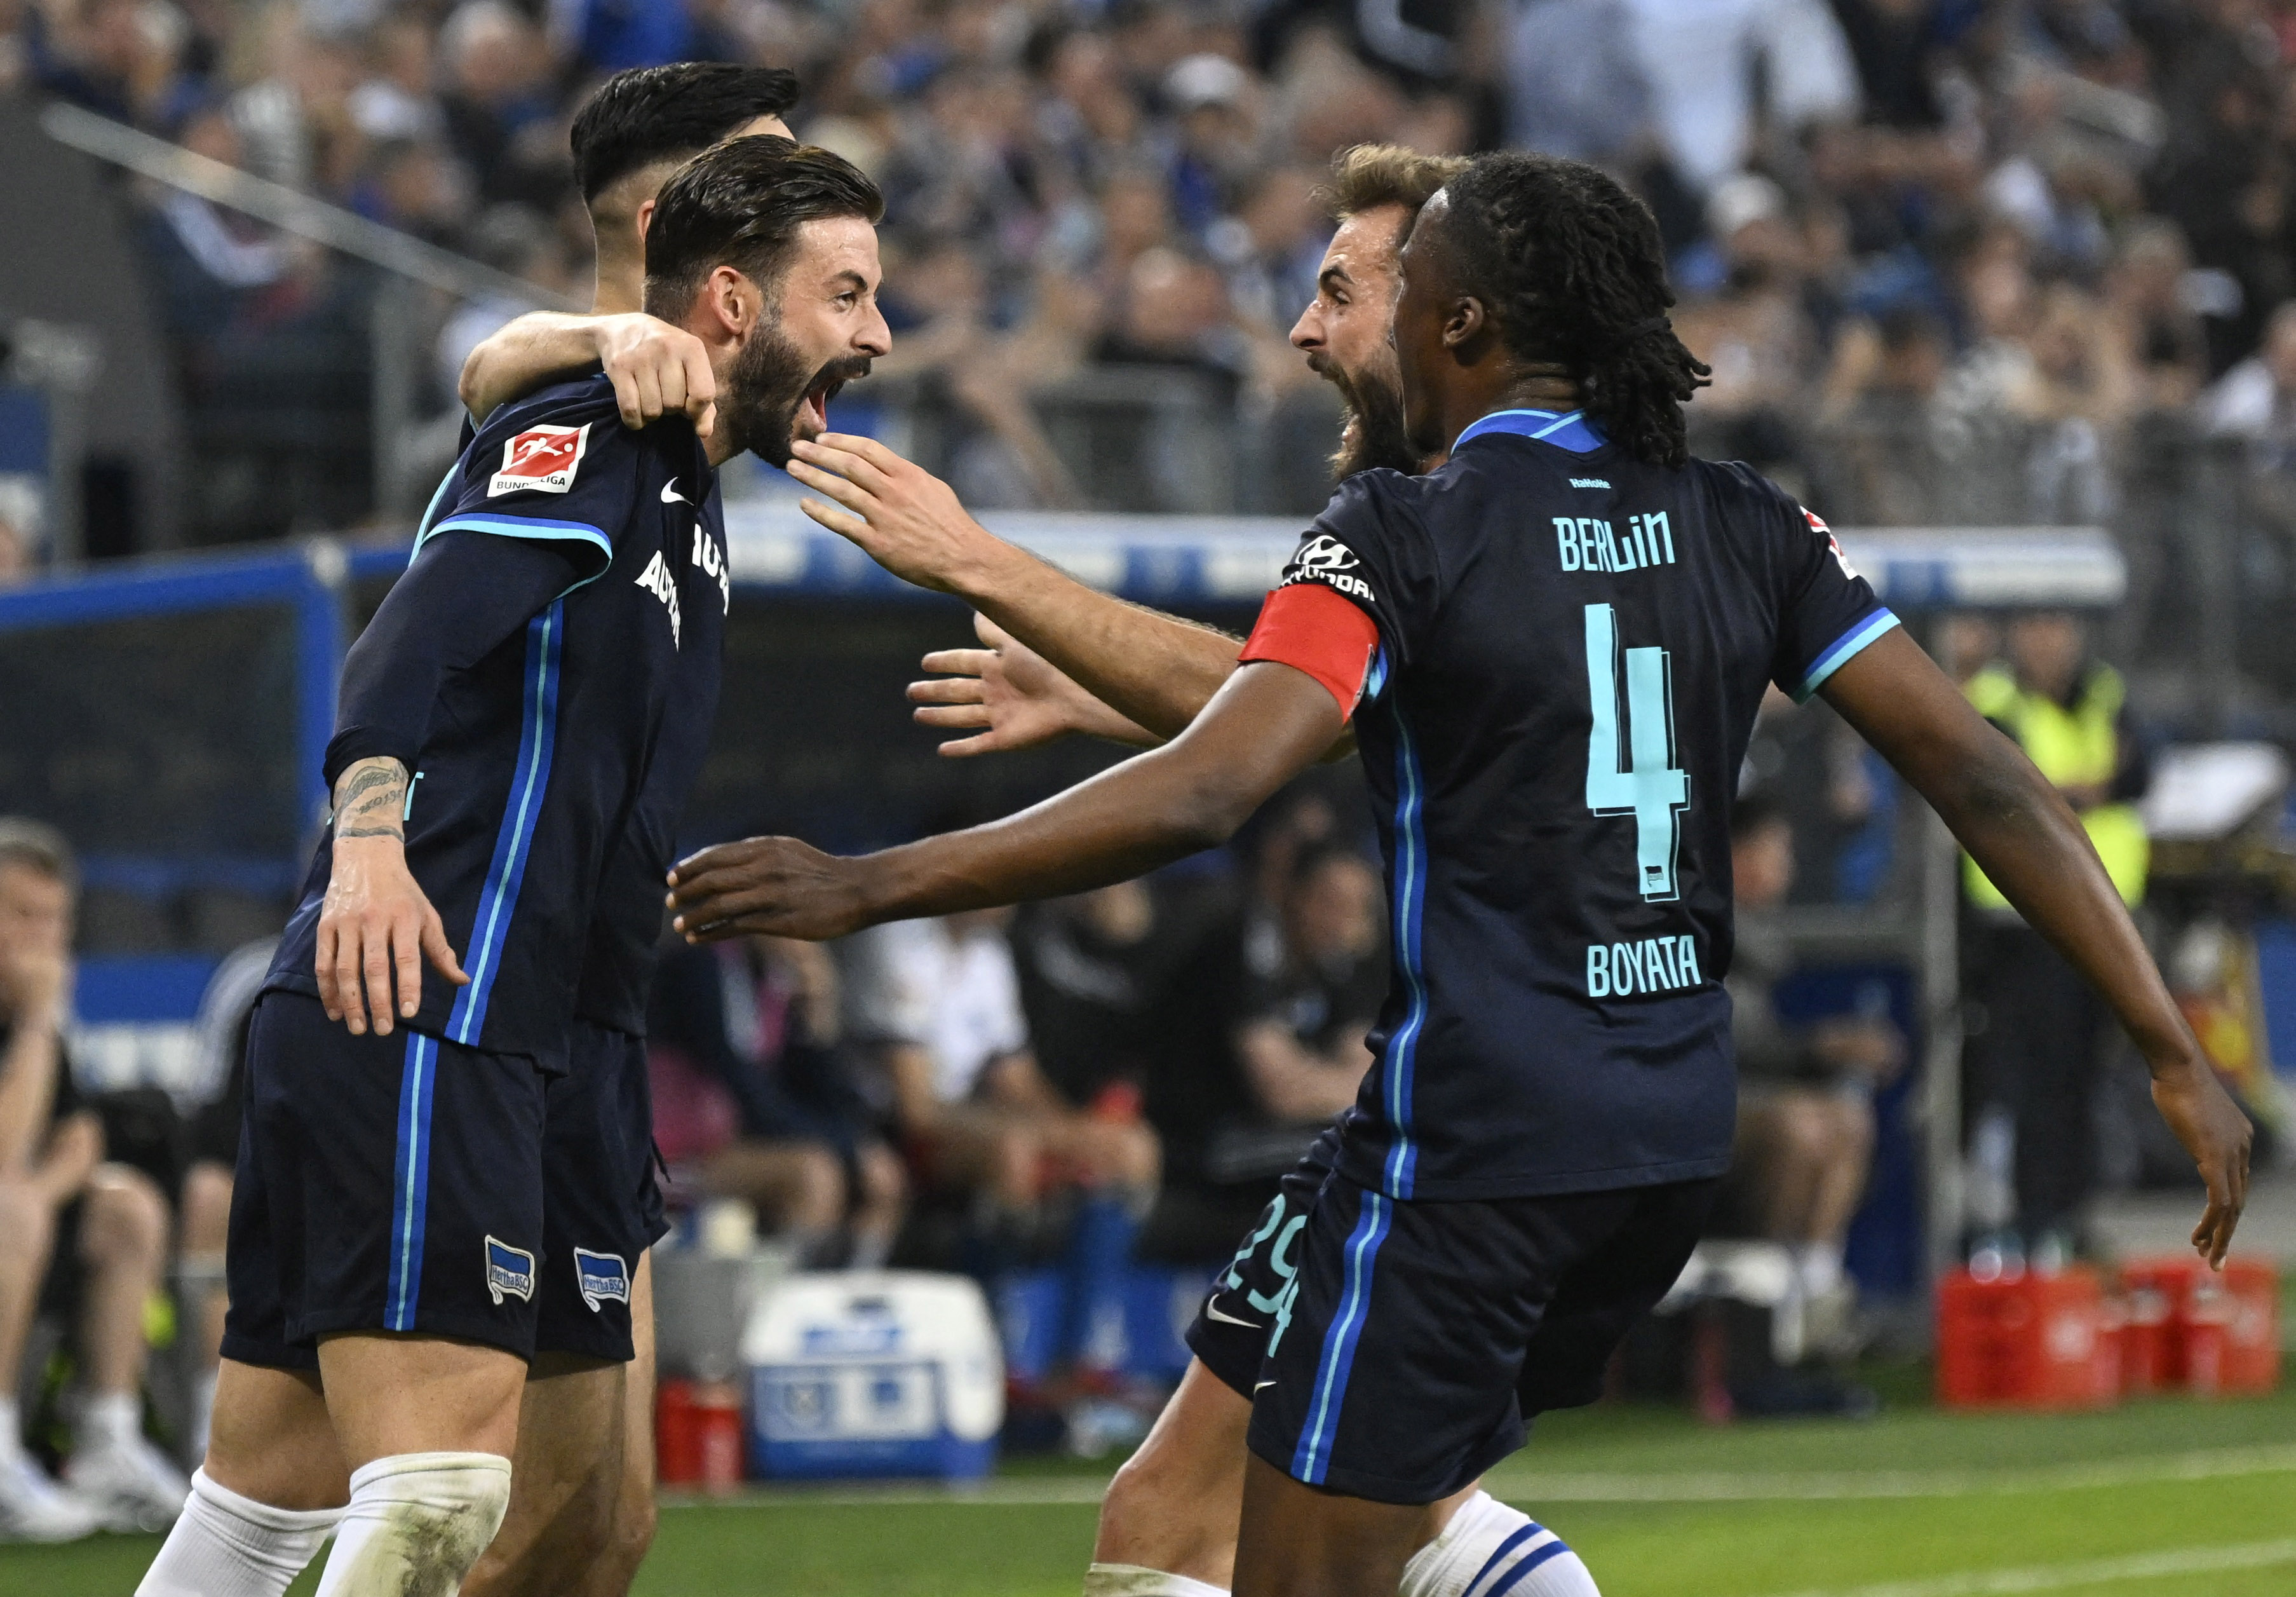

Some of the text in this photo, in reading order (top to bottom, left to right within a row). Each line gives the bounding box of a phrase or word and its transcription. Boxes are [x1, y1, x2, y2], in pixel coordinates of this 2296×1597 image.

[1569, 478, 1612, 489] HaHoHe
[1585, 602, 1691, 902] 4
[1588, 935, 1702, 997] BOYATA
